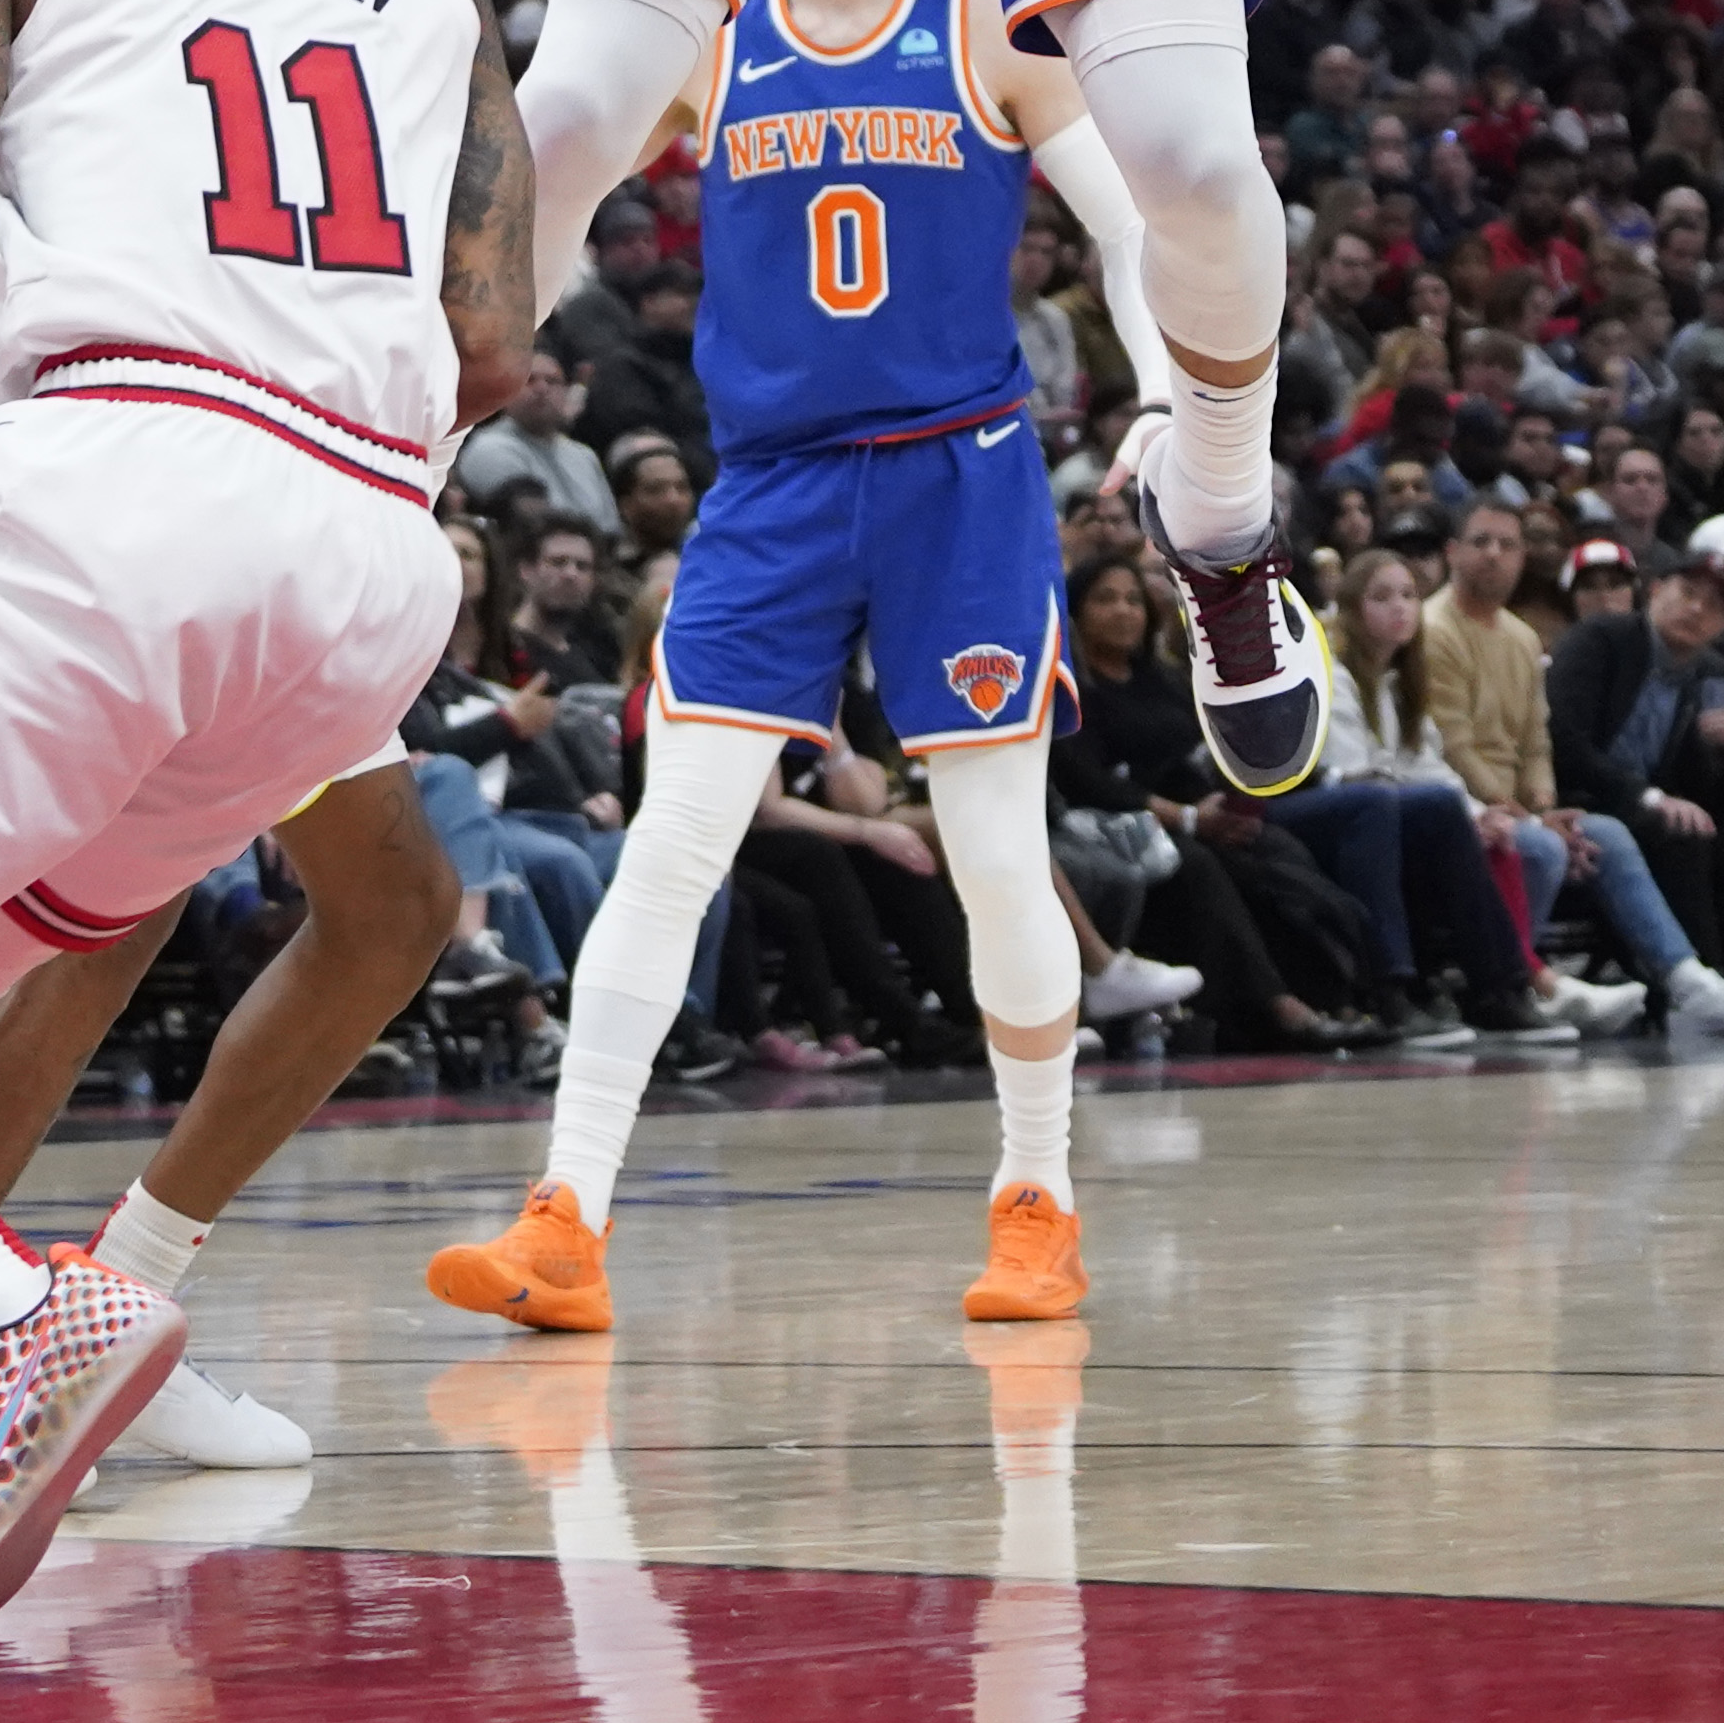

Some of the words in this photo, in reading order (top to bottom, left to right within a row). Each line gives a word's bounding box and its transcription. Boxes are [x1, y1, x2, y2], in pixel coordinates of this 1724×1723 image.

[181, 17, 413, 278] 11
[723, 108, 829, 183] NEW
[830, 105, 966, 171] YORK
[805, 183, 890, 319] 0
[951, 654, 1021, 685] KNICKS
